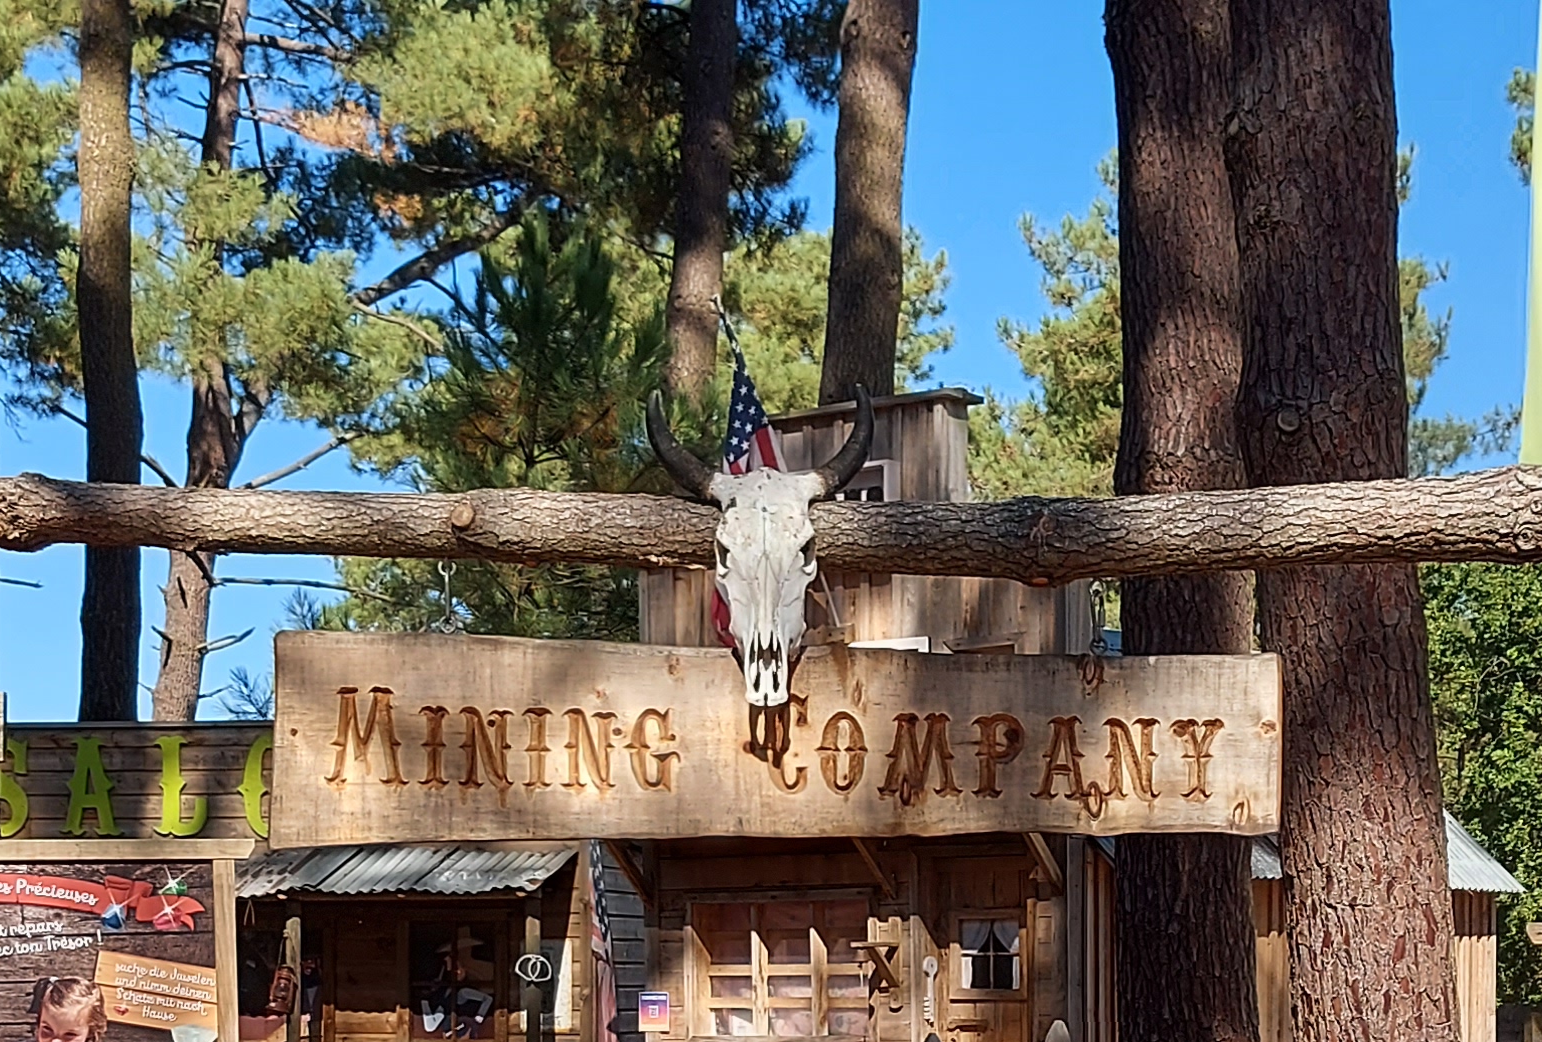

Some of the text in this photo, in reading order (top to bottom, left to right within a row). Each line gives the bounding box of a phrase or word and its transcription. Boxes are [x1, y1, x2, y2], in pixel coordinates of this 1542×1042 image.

[324, 686, 1226, 799] MINING COMPANY
[15, 879, 100, 906] Précieuses
[10, 920, 63, 940] repars
[14, 939, 43, 955] ton
[44, 935, 93, 951] Trésor
[115, 962, 148, 978] suche
[149, 966, 168, 979] die
[115, 976, 212, 1000] und nimm deinen
[116, 987, 208, 1016] Schatz mit nach
[142, 1005, 178, 1022] Hause
